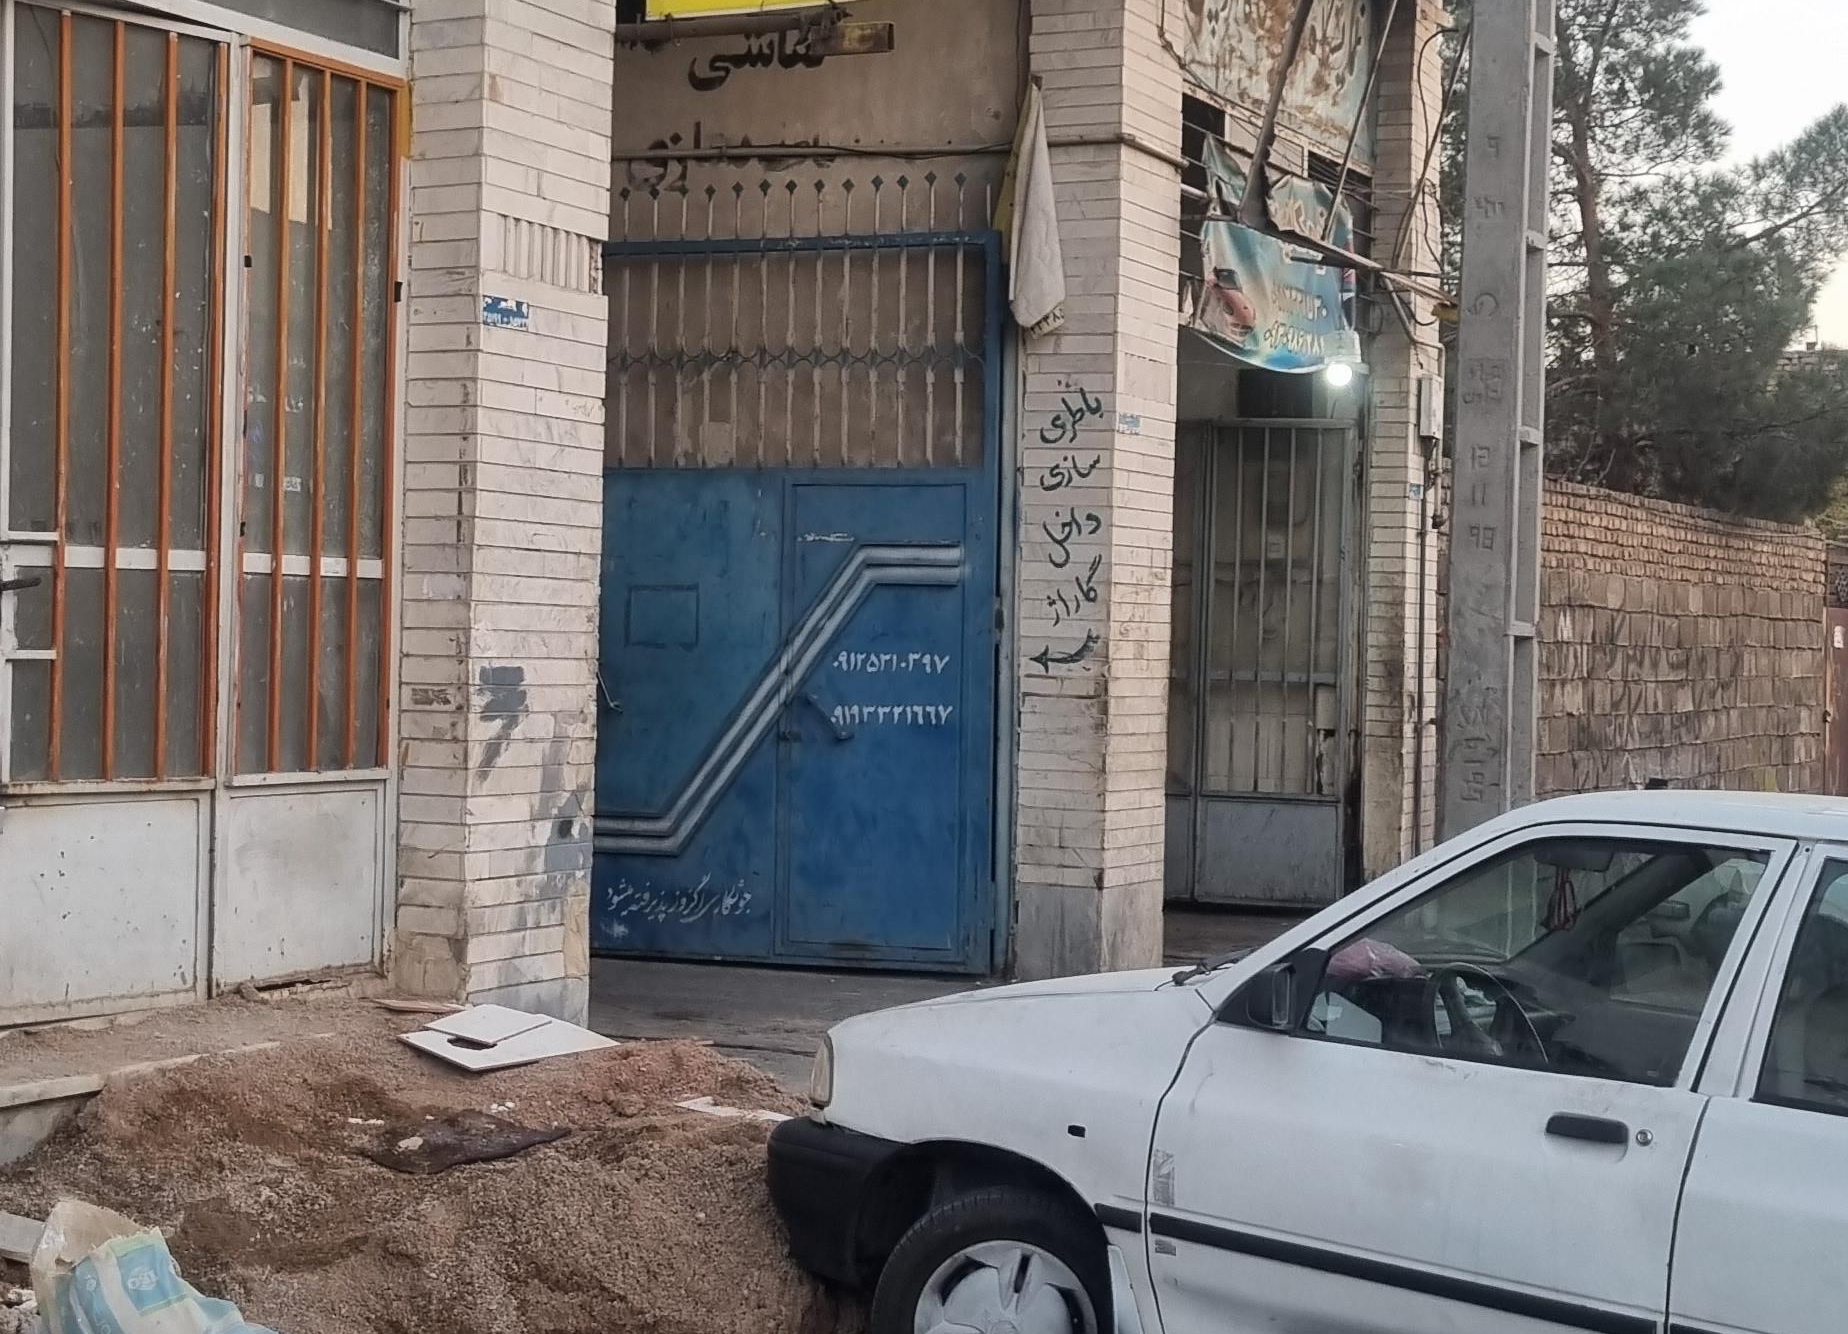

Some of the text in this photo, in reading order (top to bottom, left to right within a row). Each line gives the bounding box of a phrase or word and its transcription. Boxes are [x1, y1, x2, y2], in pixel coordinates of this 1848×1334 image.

[1040, 387, 1103, 443] باطری
[1040, 454, 1100, 491] سازی
[1043, 507, 1101, 568] داخل
[1047, 554, 1102, 627] گاراژ
